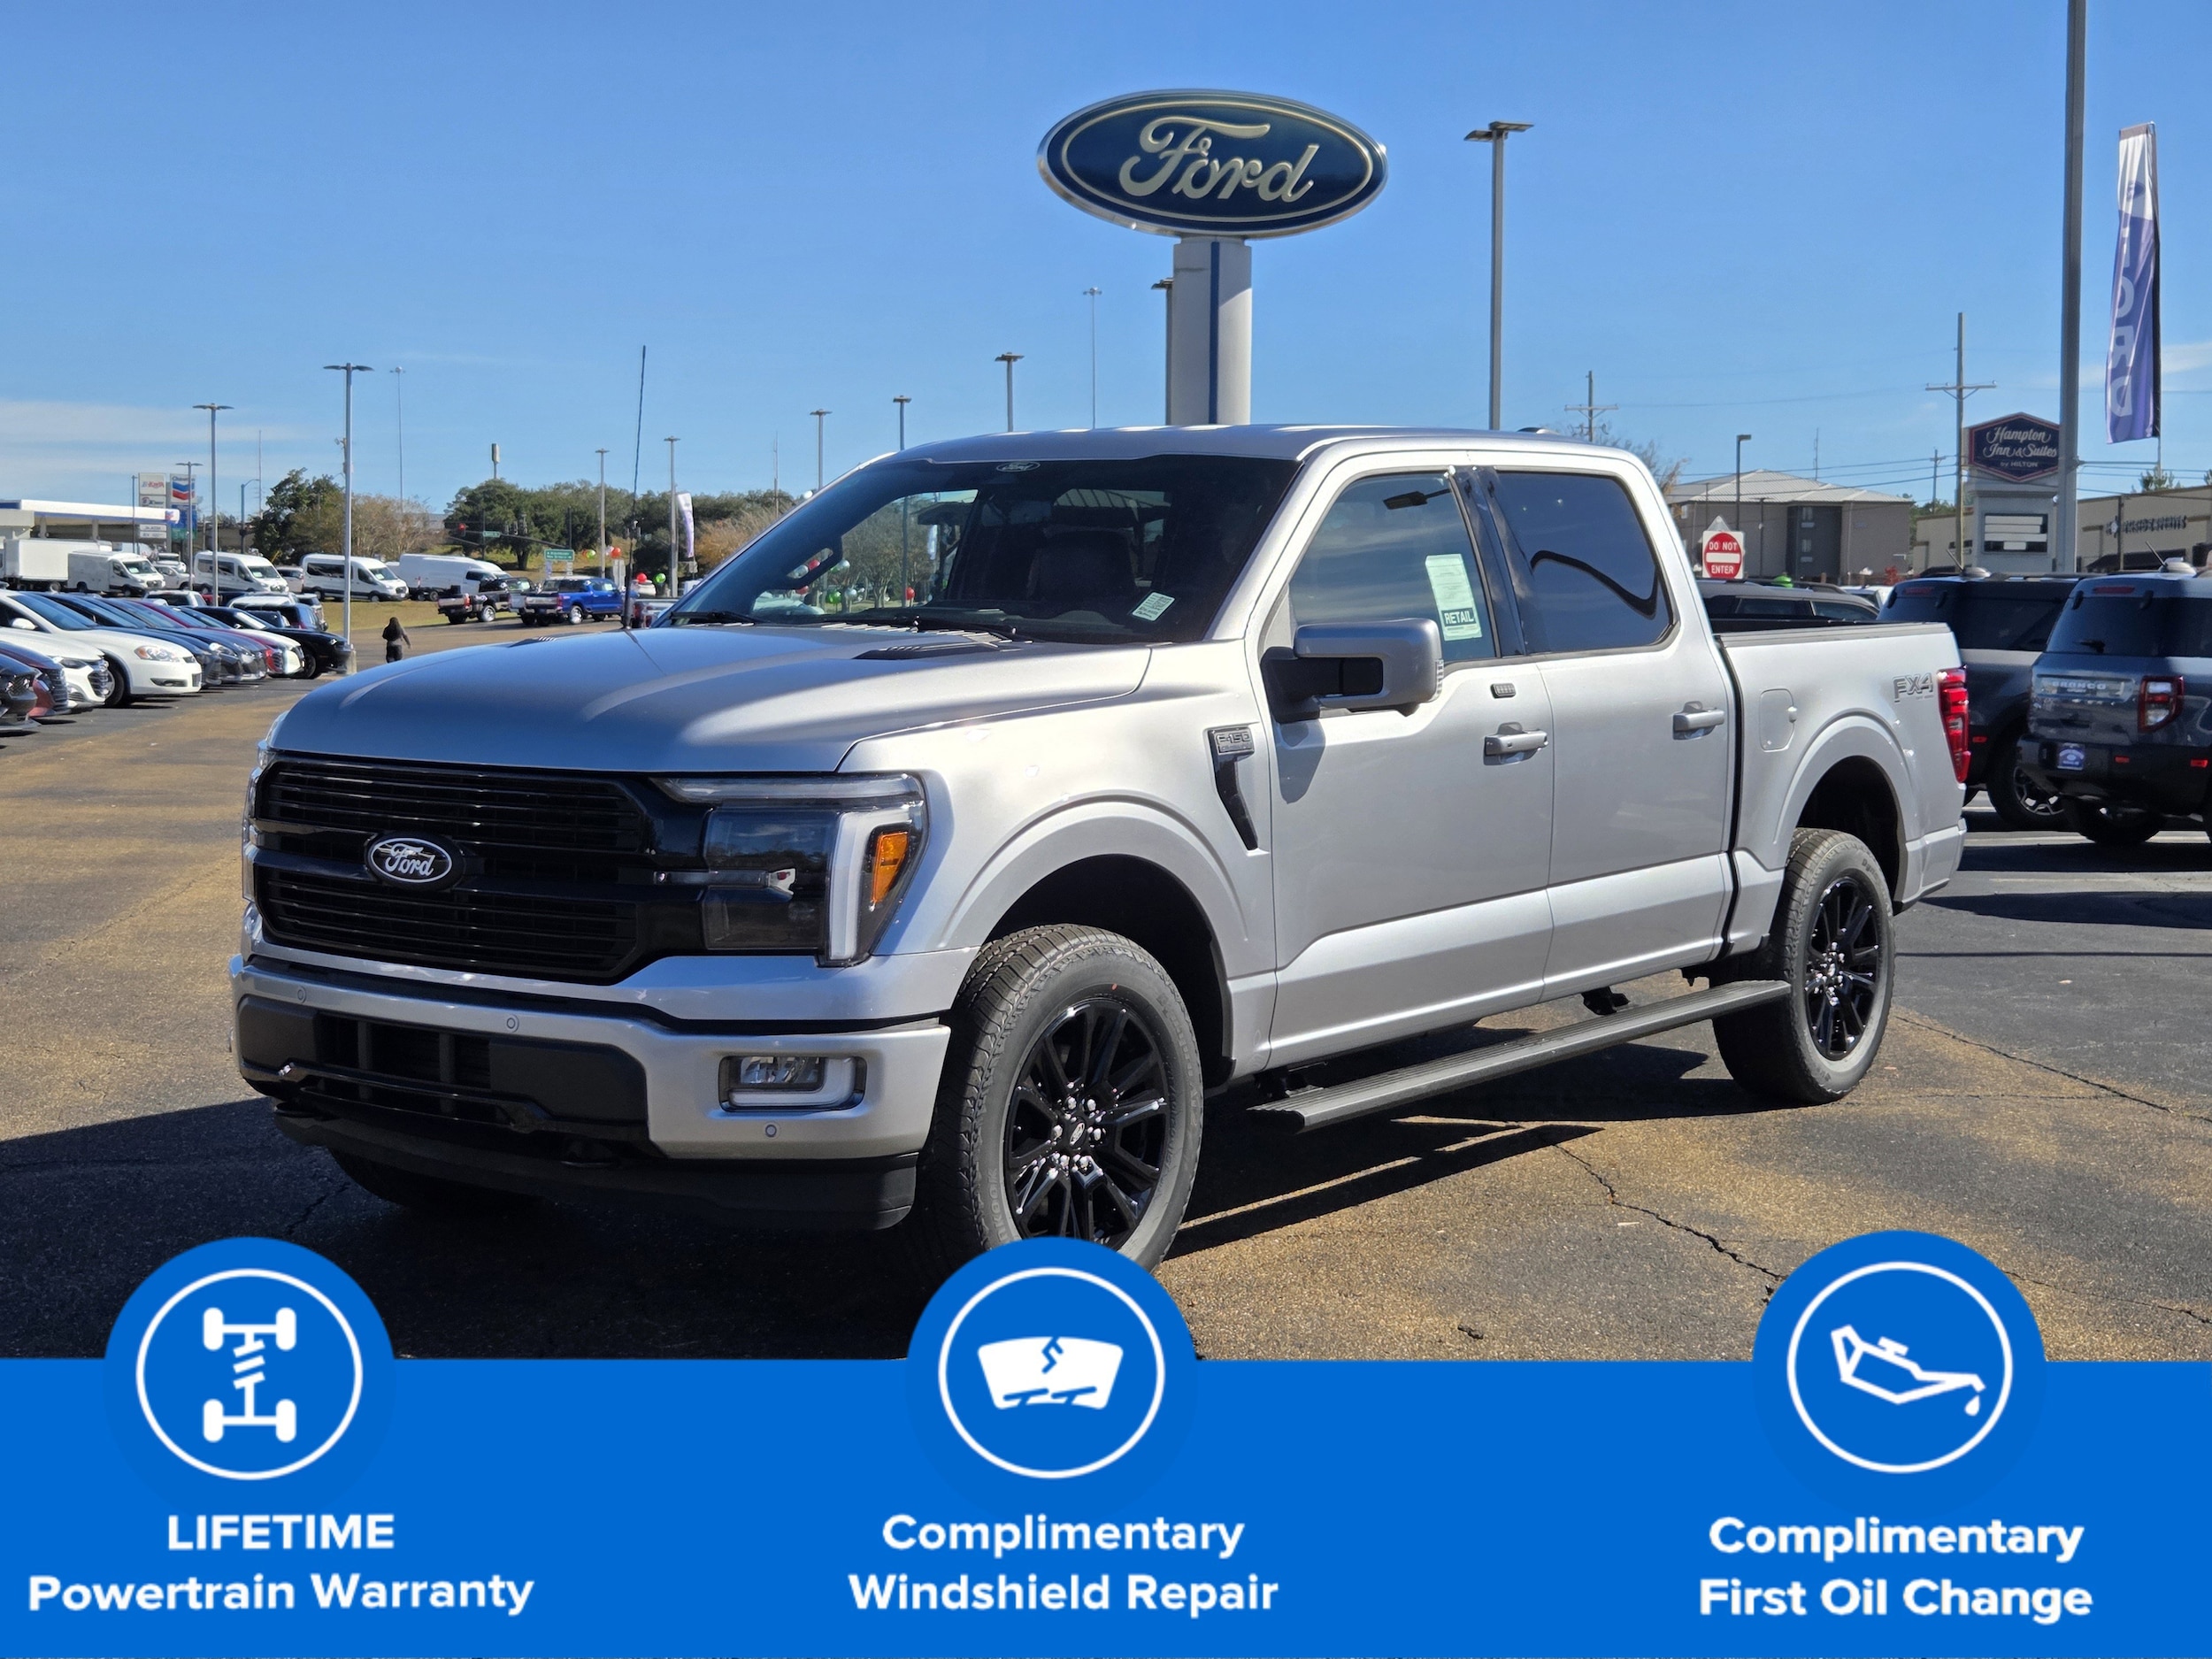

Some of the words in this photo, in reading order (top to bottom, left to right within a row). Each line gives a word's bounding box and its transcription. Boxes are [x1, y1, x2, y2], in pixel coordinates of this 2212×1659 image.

[1119, 116, 1320, 203] Ford
[1985, 426, 2051, 443] Hampton
[1983, 443, 2016, 457] Inn
[2016, 448, 2024, 457] &
[2023, 443, 2057, 457] Suites
[1709, 541, 1718, 550] DO
[1722, 541, 1737, 550] NOT
[1711, 565, 1734, 574] ENTER
[1444, 611, 1474, 625] RETAIL
[1893, 672, 1933, 703] FX4
[2053, 680, 2107, 690] BRONCO
[1216, 731, 1251, 745] F-150
[385, 843, 436, 876] Ford
